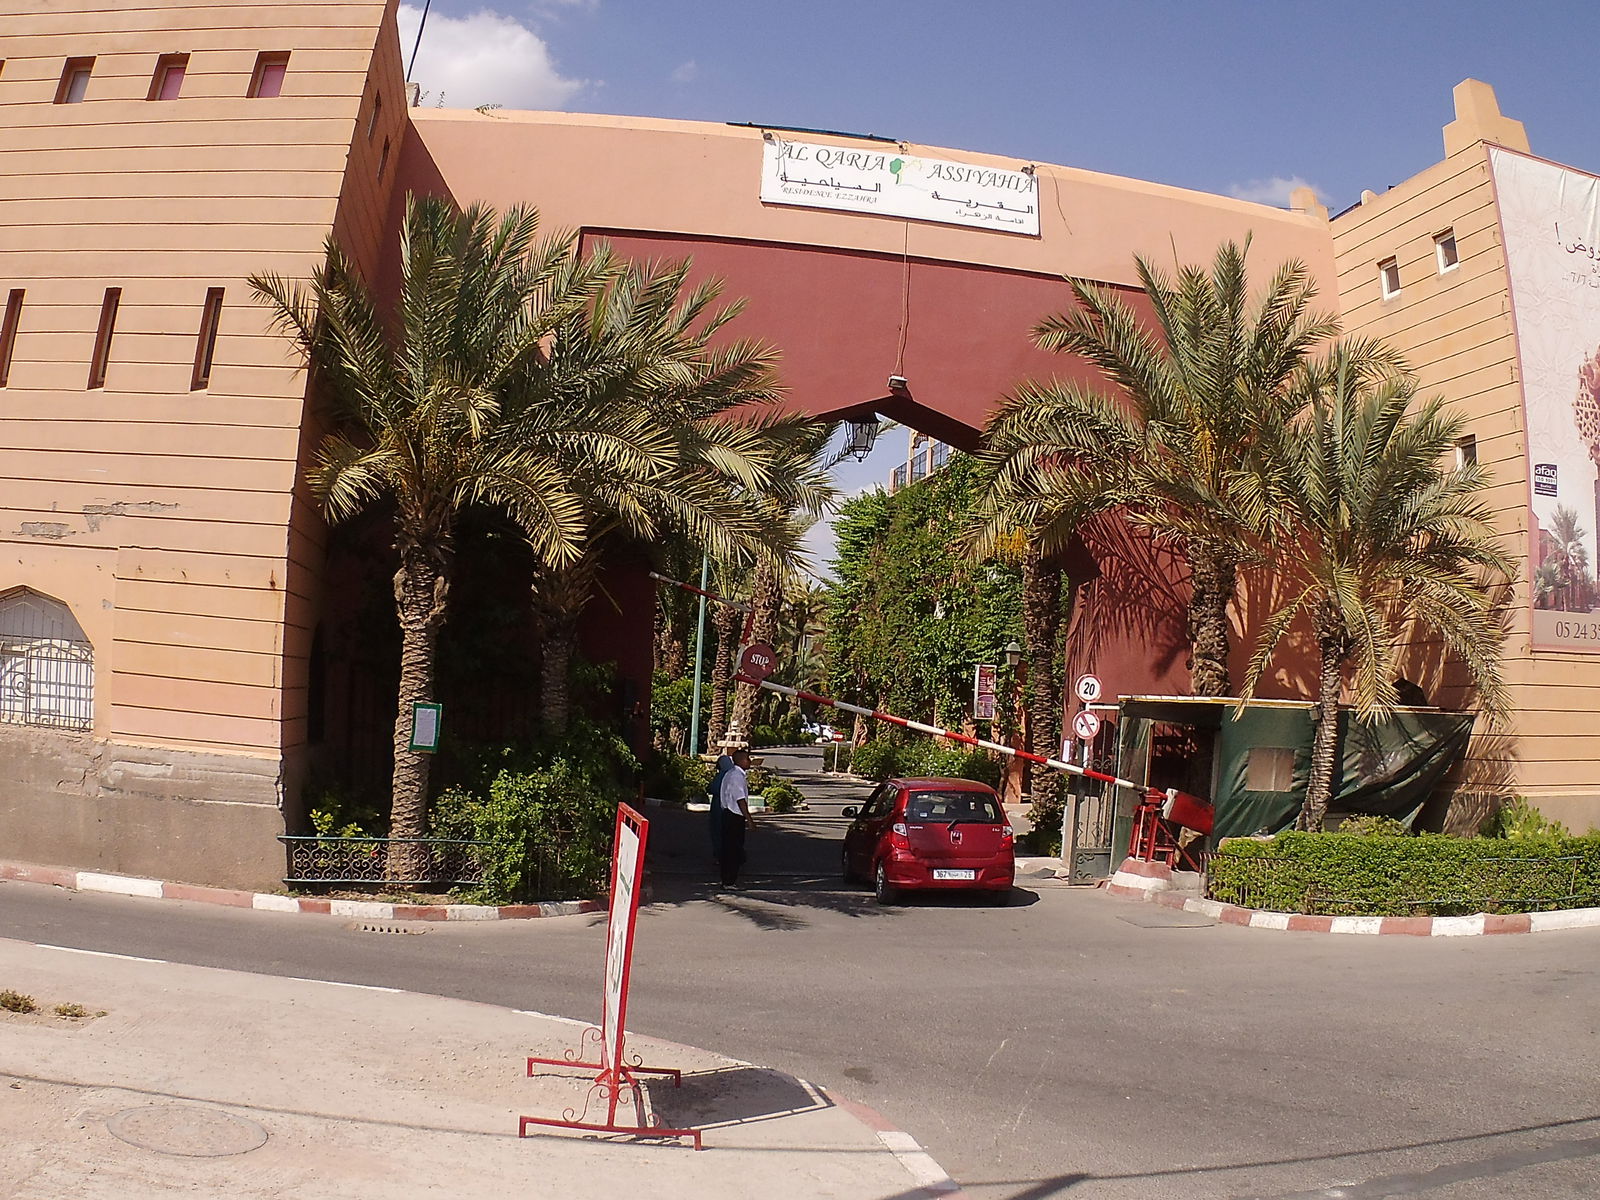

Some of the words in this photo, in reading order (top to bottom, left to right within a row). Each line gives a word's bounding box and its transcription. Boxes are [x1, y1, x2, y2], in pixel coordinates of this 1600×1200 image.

[775, 144, 808, 161] AL
[816, 149, 885, 171] QARIA
[927, 164, 1034, 193] ASSIYAHIA
[780, 172, 881, 193] السياحية
[782, 187, 832, 199] RESIDENCE
[835, 192, 878, 204] EZZAHRA
[931, 191, 1034, 214] القرية
[1535, 465, 1556, 479] afaq
[1555, 621, 1570, 638] 05
[1573, 622, 1588, 639] 24
[750, 653, 769, 665] STOP
[1083, 682, 1095, 696] 20
